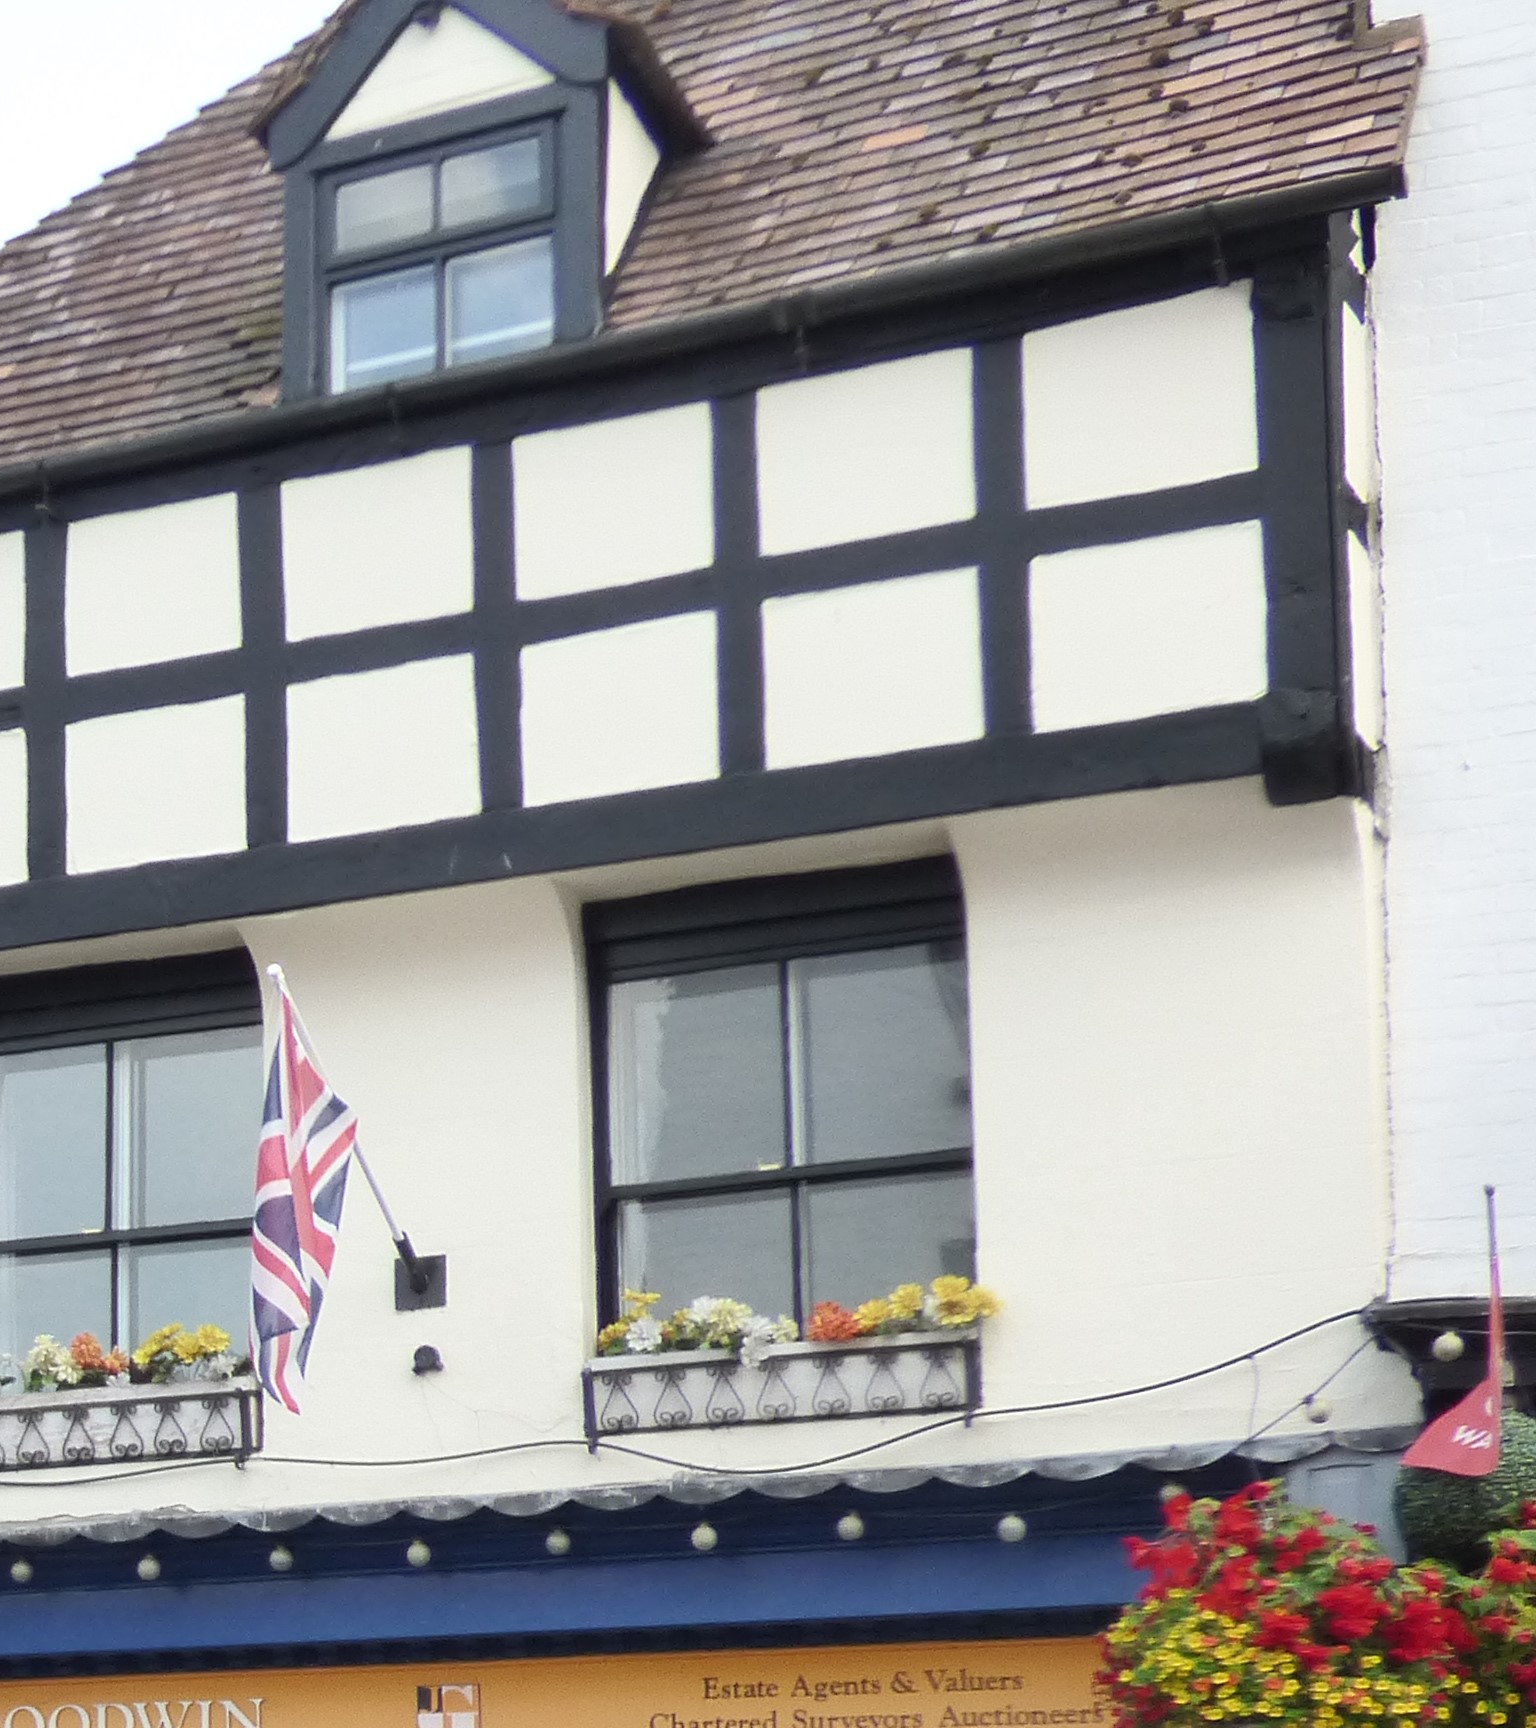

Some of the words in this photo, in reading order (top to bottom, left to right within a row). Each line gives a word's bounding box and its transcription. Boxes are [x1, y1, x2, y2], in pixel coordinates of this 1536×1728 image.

[702, 1677, 779, 1700] Estate
[791, 1674, 881, 1702] Agents
[890, 1671, 918, 1694] &
[925, 1668, 1024, 1692] Valuers
